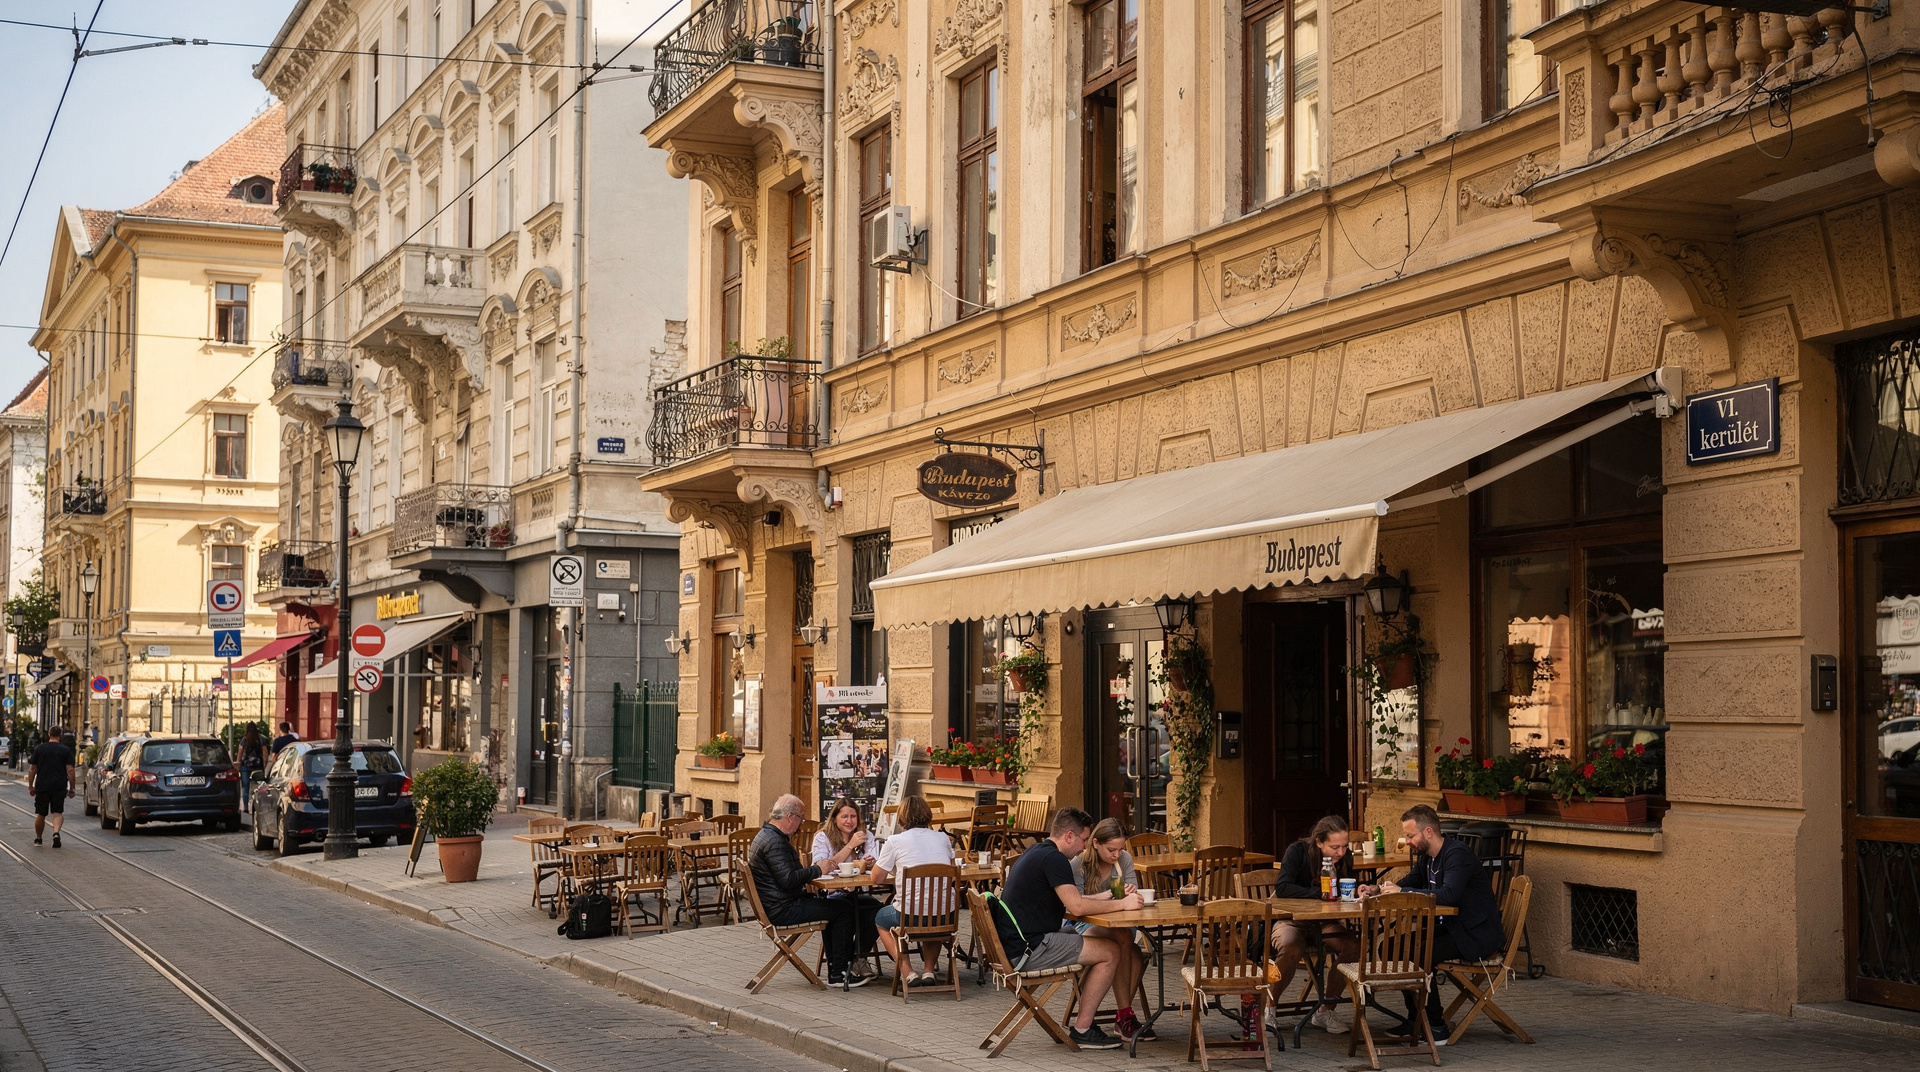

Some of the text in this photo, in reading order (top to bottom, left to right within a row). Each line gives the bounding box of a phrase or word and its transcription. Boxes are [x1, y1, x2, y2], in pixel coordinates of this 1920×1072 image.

[1716, 397, 1739, 418] VI.
[1700, 420, 1760, 451] kerülét
[923, 465, 1014, 491] Budapest
[1265, 535, 1343, 577] Budepest
